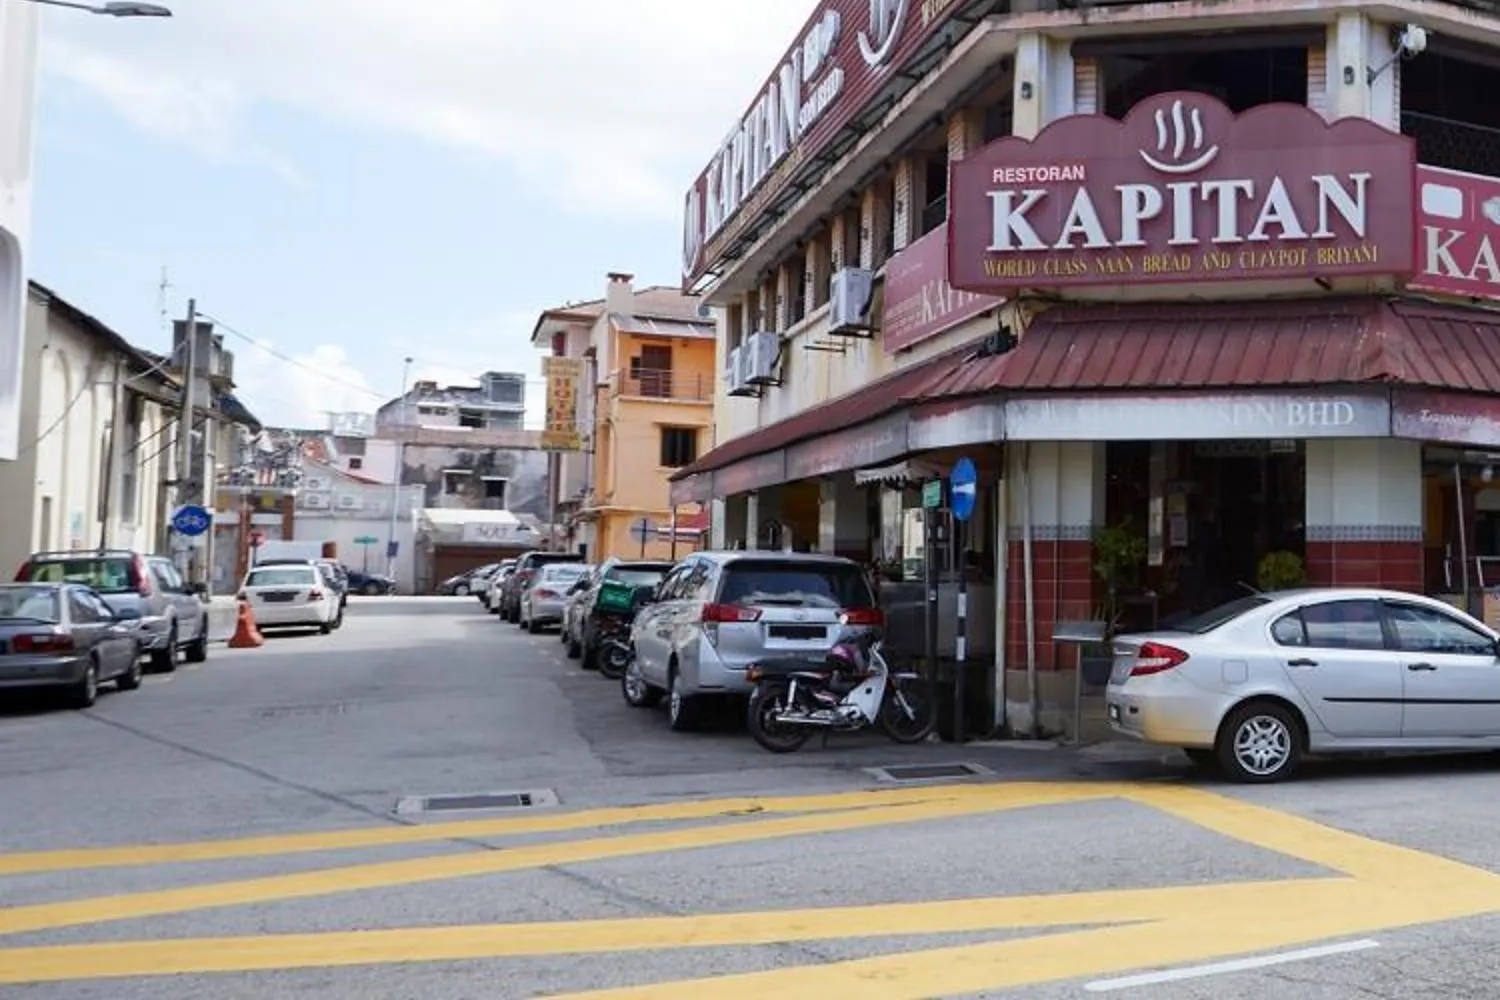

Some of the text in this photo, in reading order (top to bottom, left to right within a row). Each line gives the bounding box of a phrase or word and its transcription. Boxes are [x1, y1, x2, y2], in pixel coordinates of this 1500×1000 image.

[992, 165, 1085, 183] RESTORAN
[985, 172, 1372, 253] KAPITAN
[983, 257, 1036, 278] WORLD
[1043, 256, 1088, 276] CLASS
[1096, 254, 1134, 275] NAAN
[1143, 252, 1191, 273] BREAD
[1200, 250, 1231, 270] AND
[1317, 244, 1378, 265] BRIYANI
[1286, 399, 1354, 427] BHD
